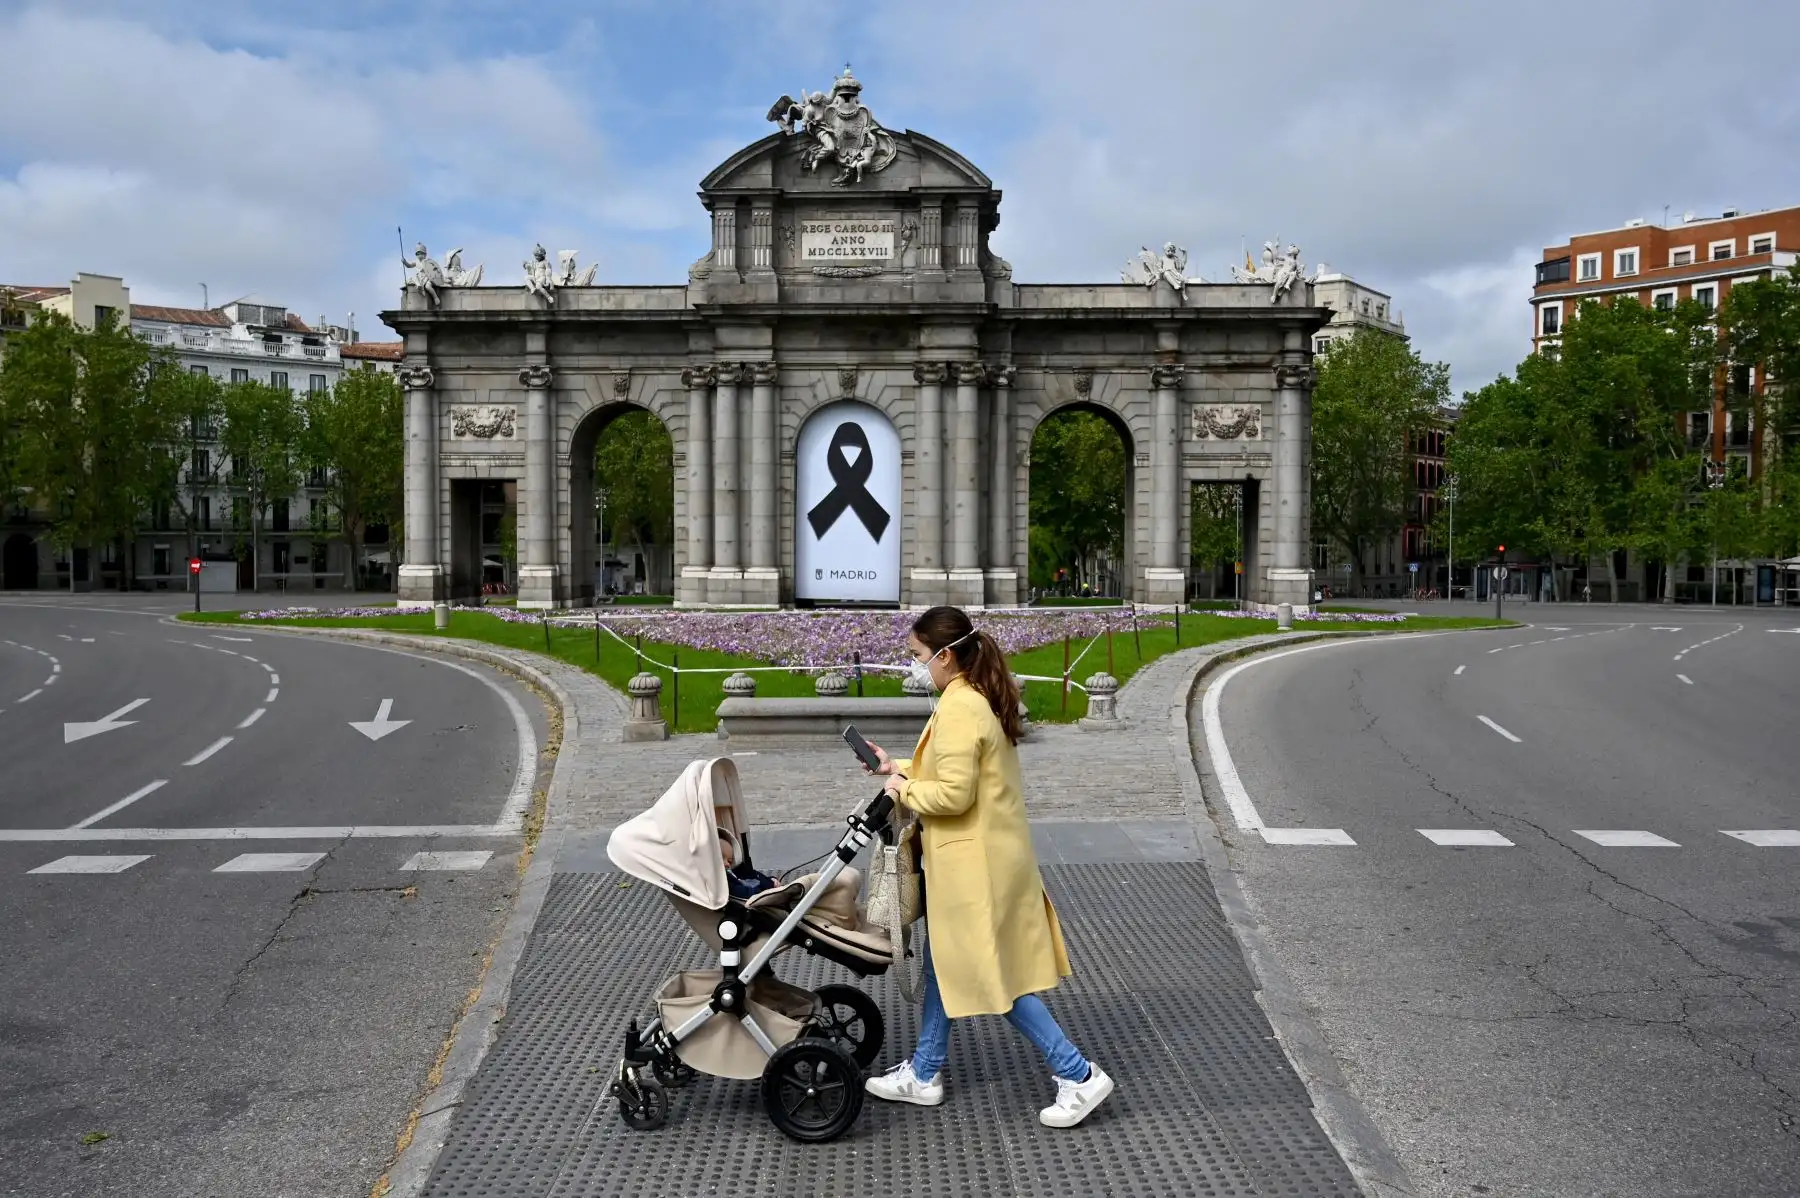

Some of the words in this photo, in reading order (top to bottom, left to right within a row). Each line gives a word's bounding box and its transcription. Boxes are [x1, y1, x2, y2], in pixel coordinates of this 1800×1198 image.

[802, 225, 831, 233] REGE
[834, 225, 879, 233] CAROLO
[882, 225, 895, 233] III
[831, 236, 866, 245] ANNO
[808, 248, 888, 256] MDCCLXXVIII
[830, 570, 877, 580] MADRID
